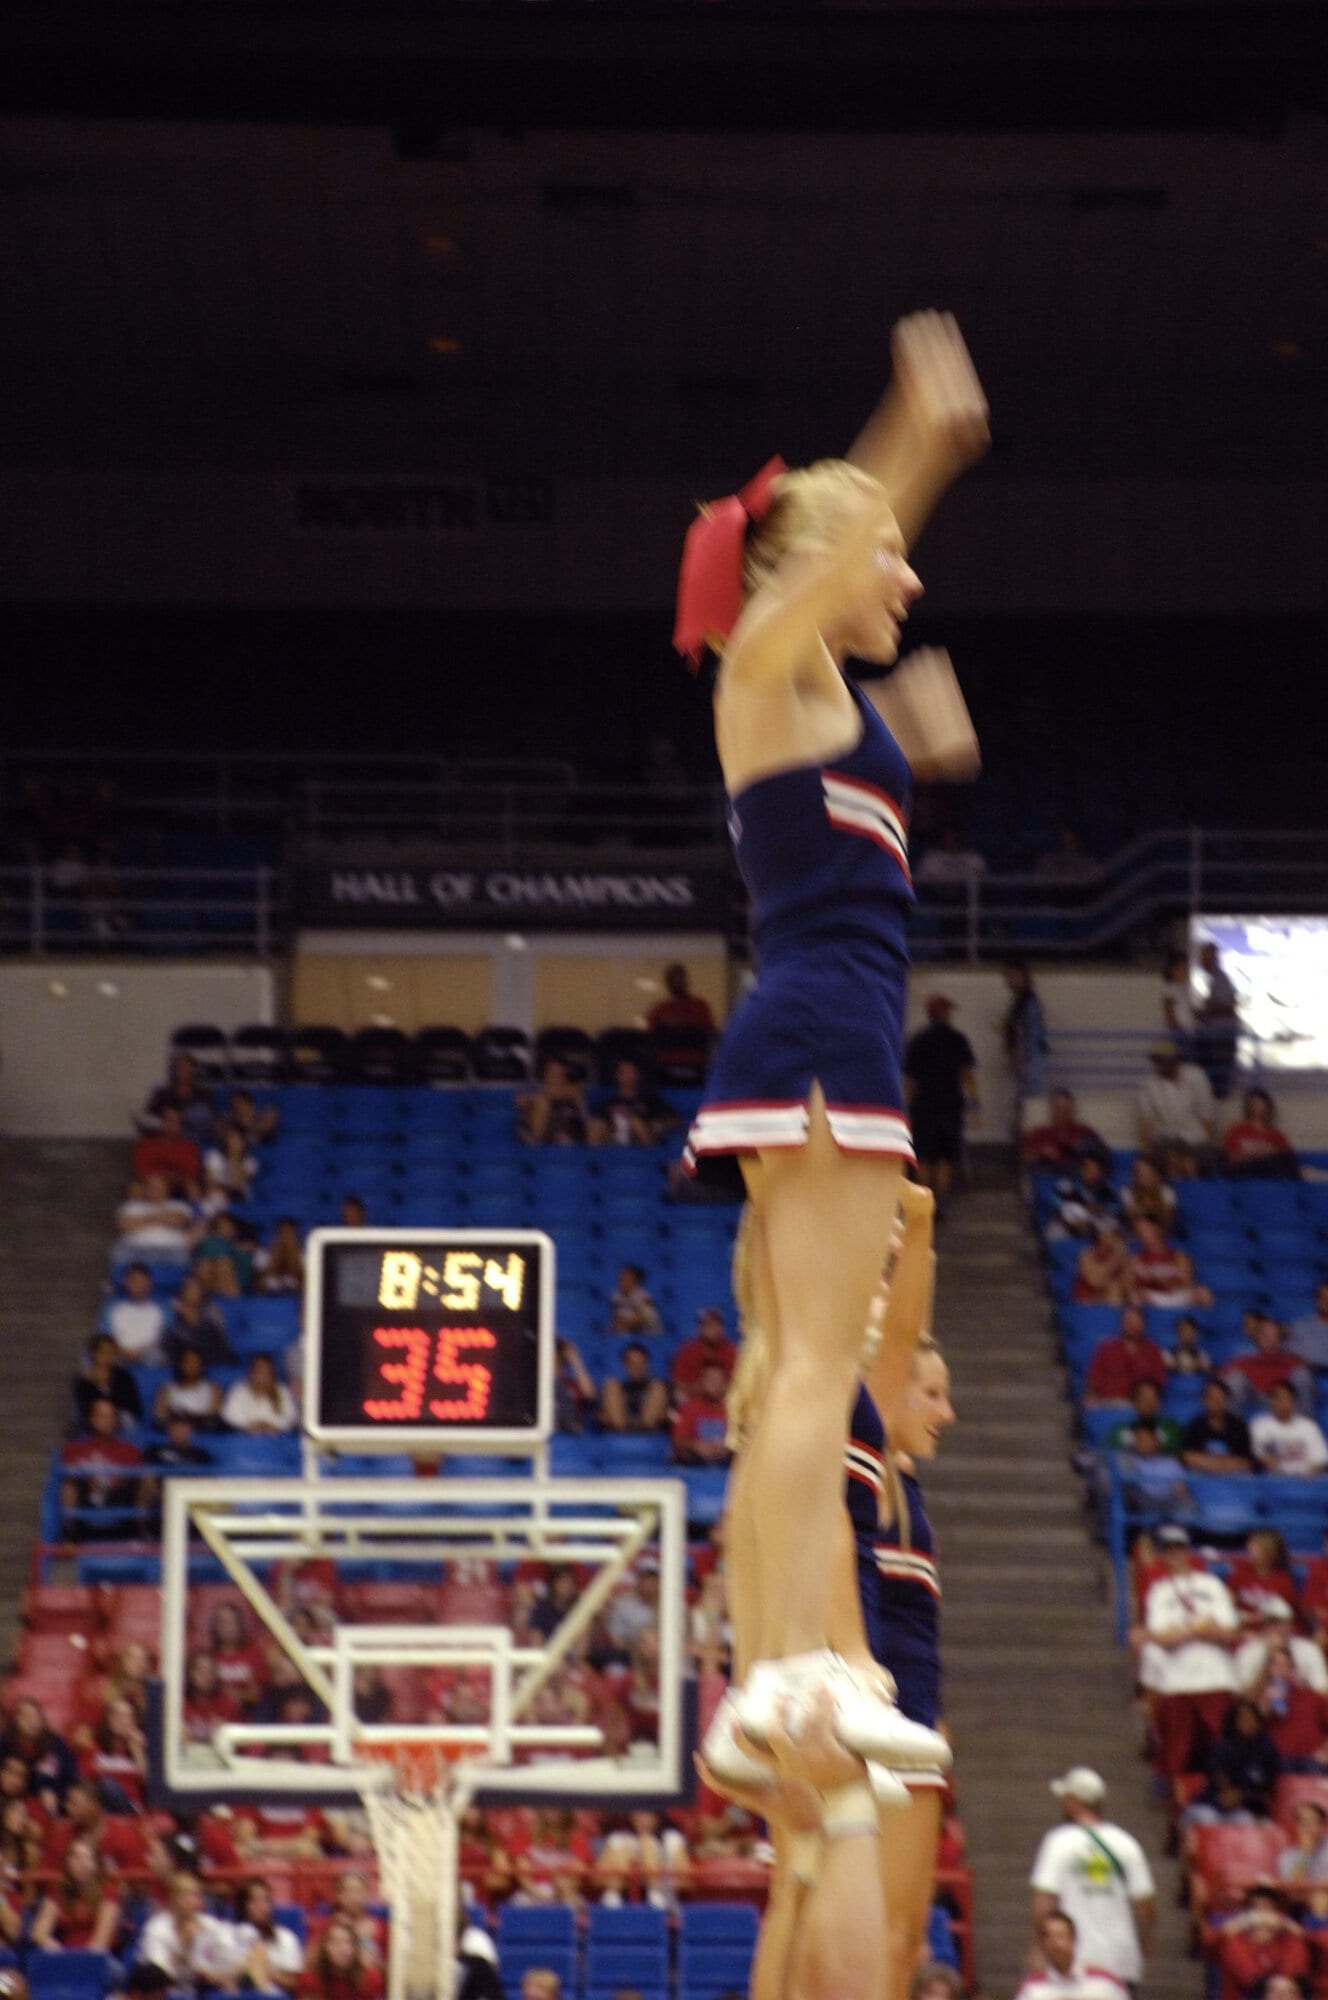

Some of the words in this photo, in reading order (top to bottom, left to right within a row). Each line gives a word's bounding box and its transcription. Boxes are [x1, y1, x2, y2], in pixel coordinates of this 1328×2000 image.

[331, 873, 418, 903] HALL
[429, 873, 475, 904] OF
[484, 872, 694, 905] CHAMPIONS
[378, 1251, 526, 1311] 8:54
[363, 1327, 497, 1420] 35
